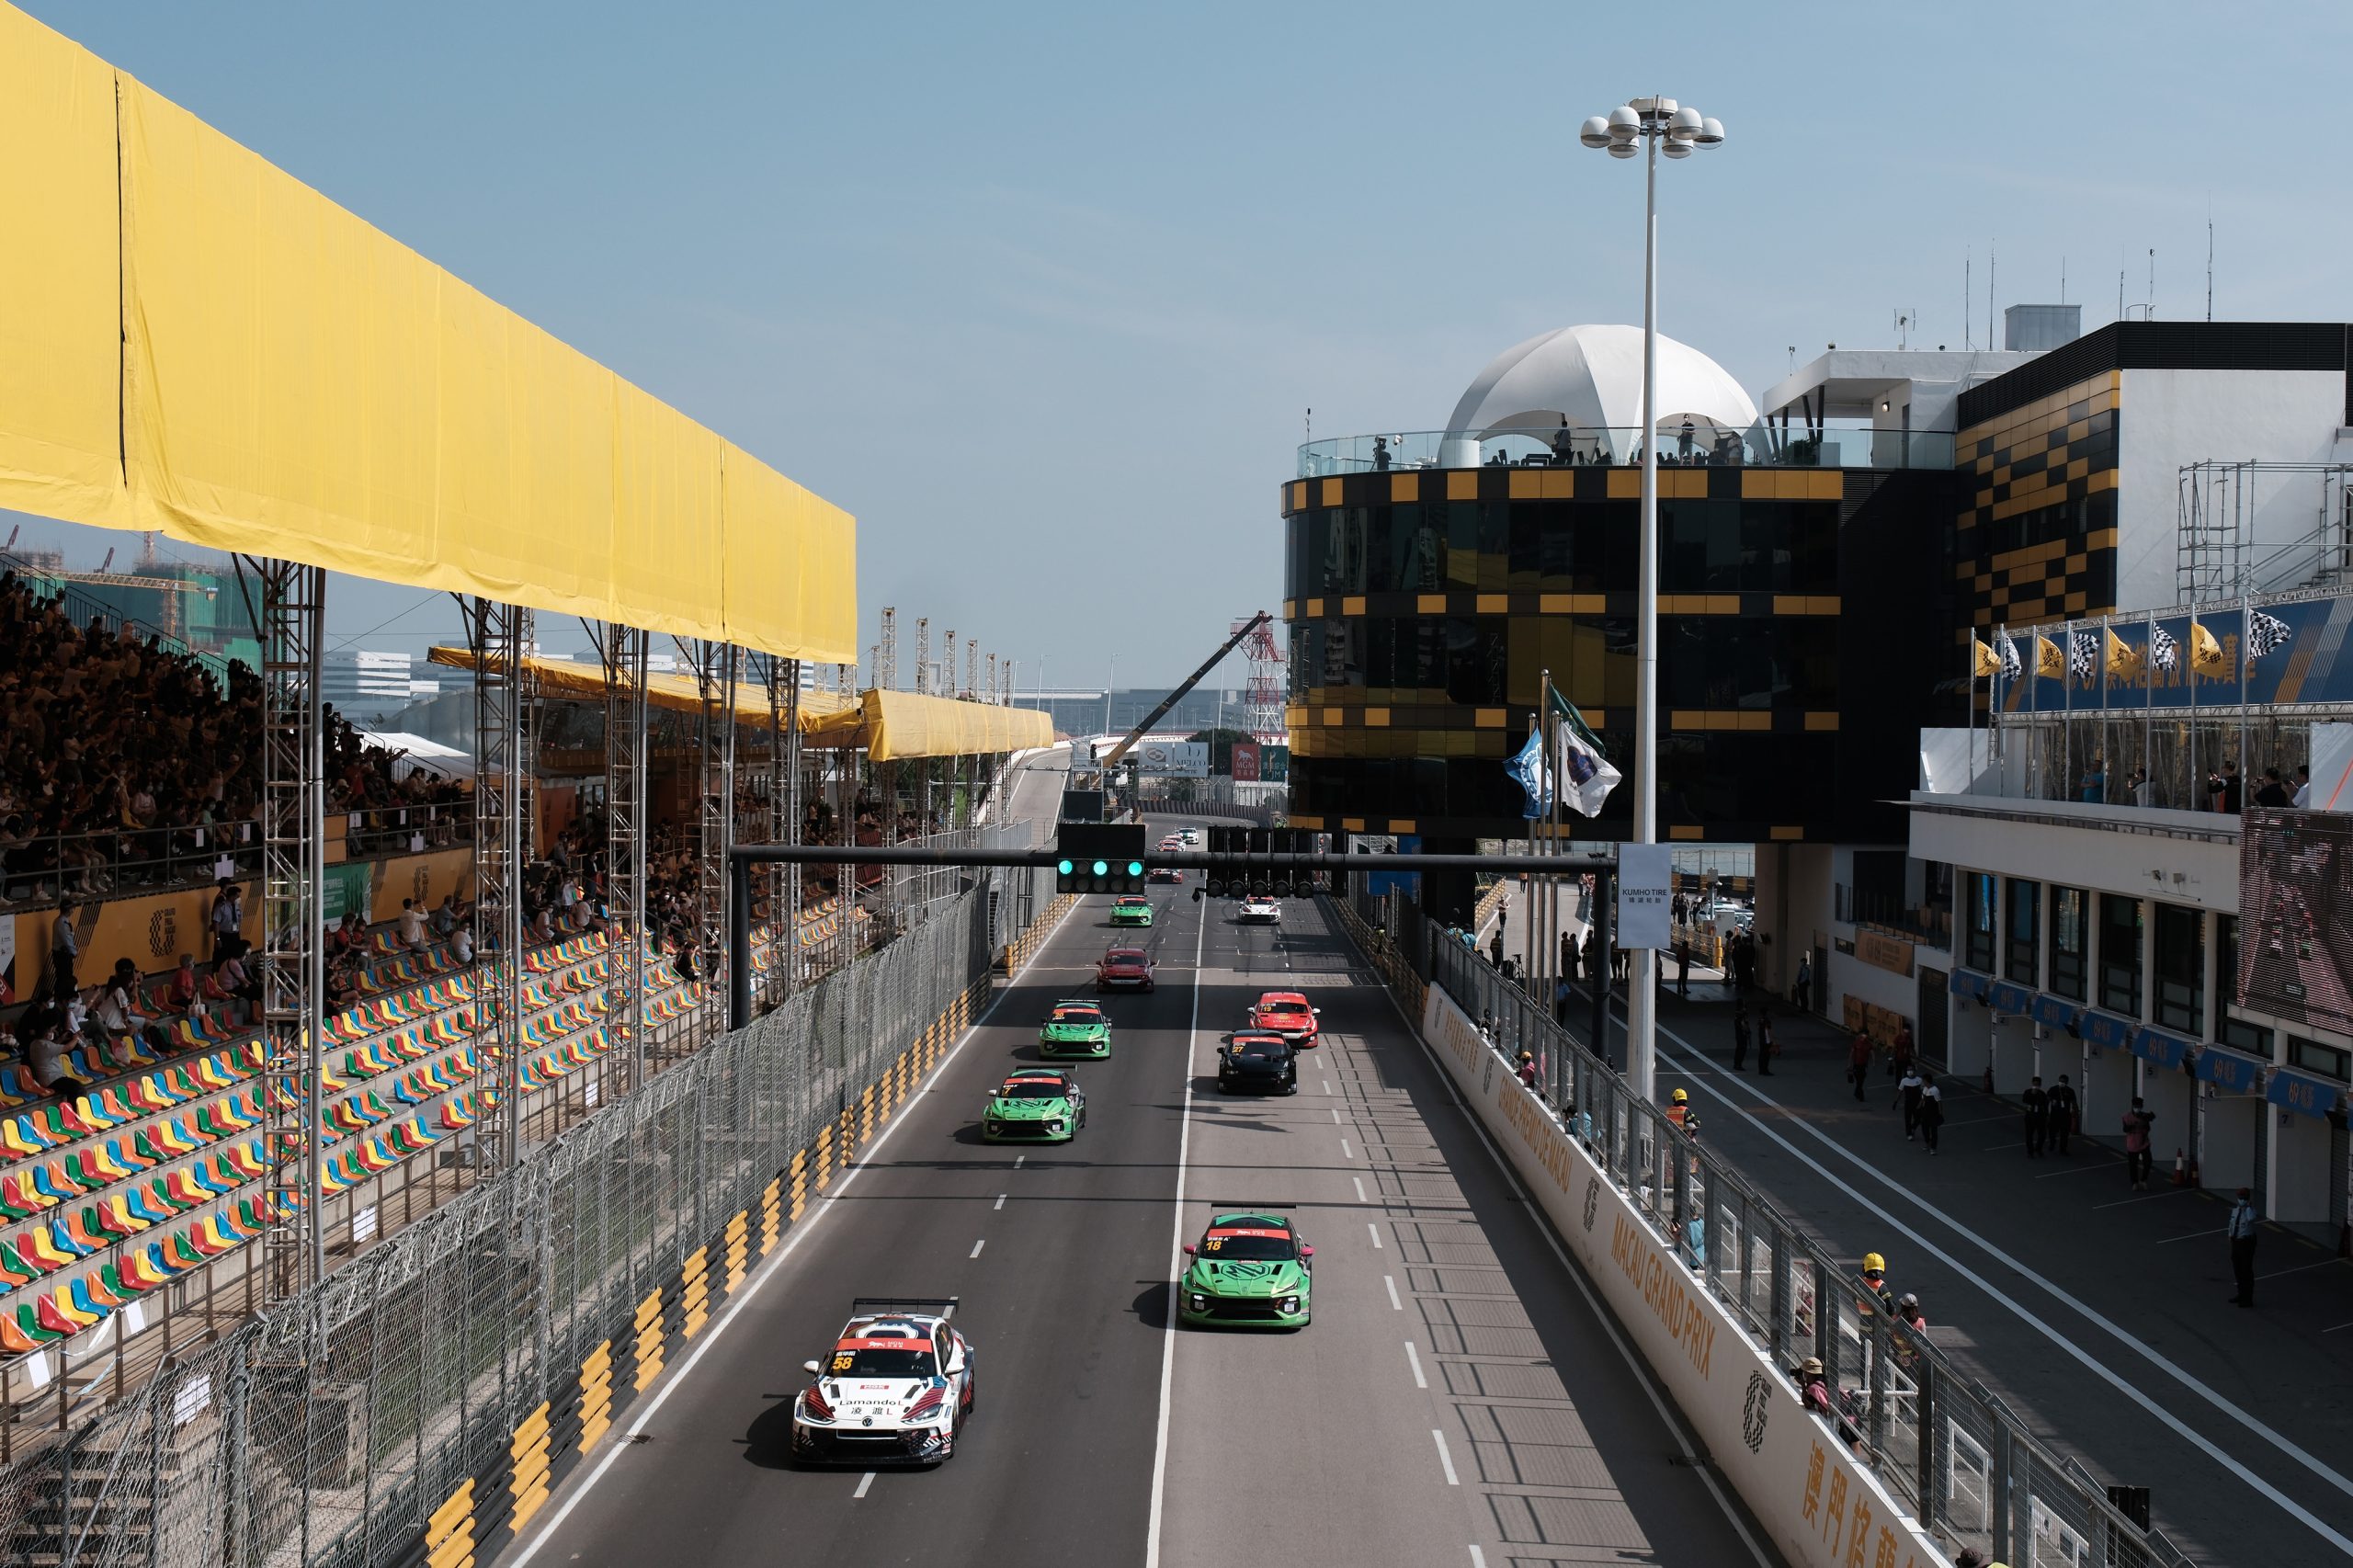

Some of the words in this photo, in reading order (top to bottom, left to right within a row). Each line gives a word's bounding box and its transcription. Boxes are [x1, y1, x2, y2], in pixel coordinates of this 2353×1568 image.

[1262, 761, 1286, 770] 澳綜合
[2147, 1066, 2154, 1075] 5
[2214, 1058, 2222, 1079] 69
[2289, 1080, 2300, 1104] 69
[2281, 1114, 2288, 1124] 7
[1539, 1123, 1551, 1166] DE
[1547, 1135, 1573, 1194] MACAU
[1206, 1241, 1222, 1251] 18
[1611, 1212, 1647, 1290] MACAU
[1644, 1253, 1684, 1339] GRAND
[1682, 1298, 1716, 1381] PRIX
[832, 1357, 853, 1370] 58
[1802, 1438, 1924, 1568] 澳門格
